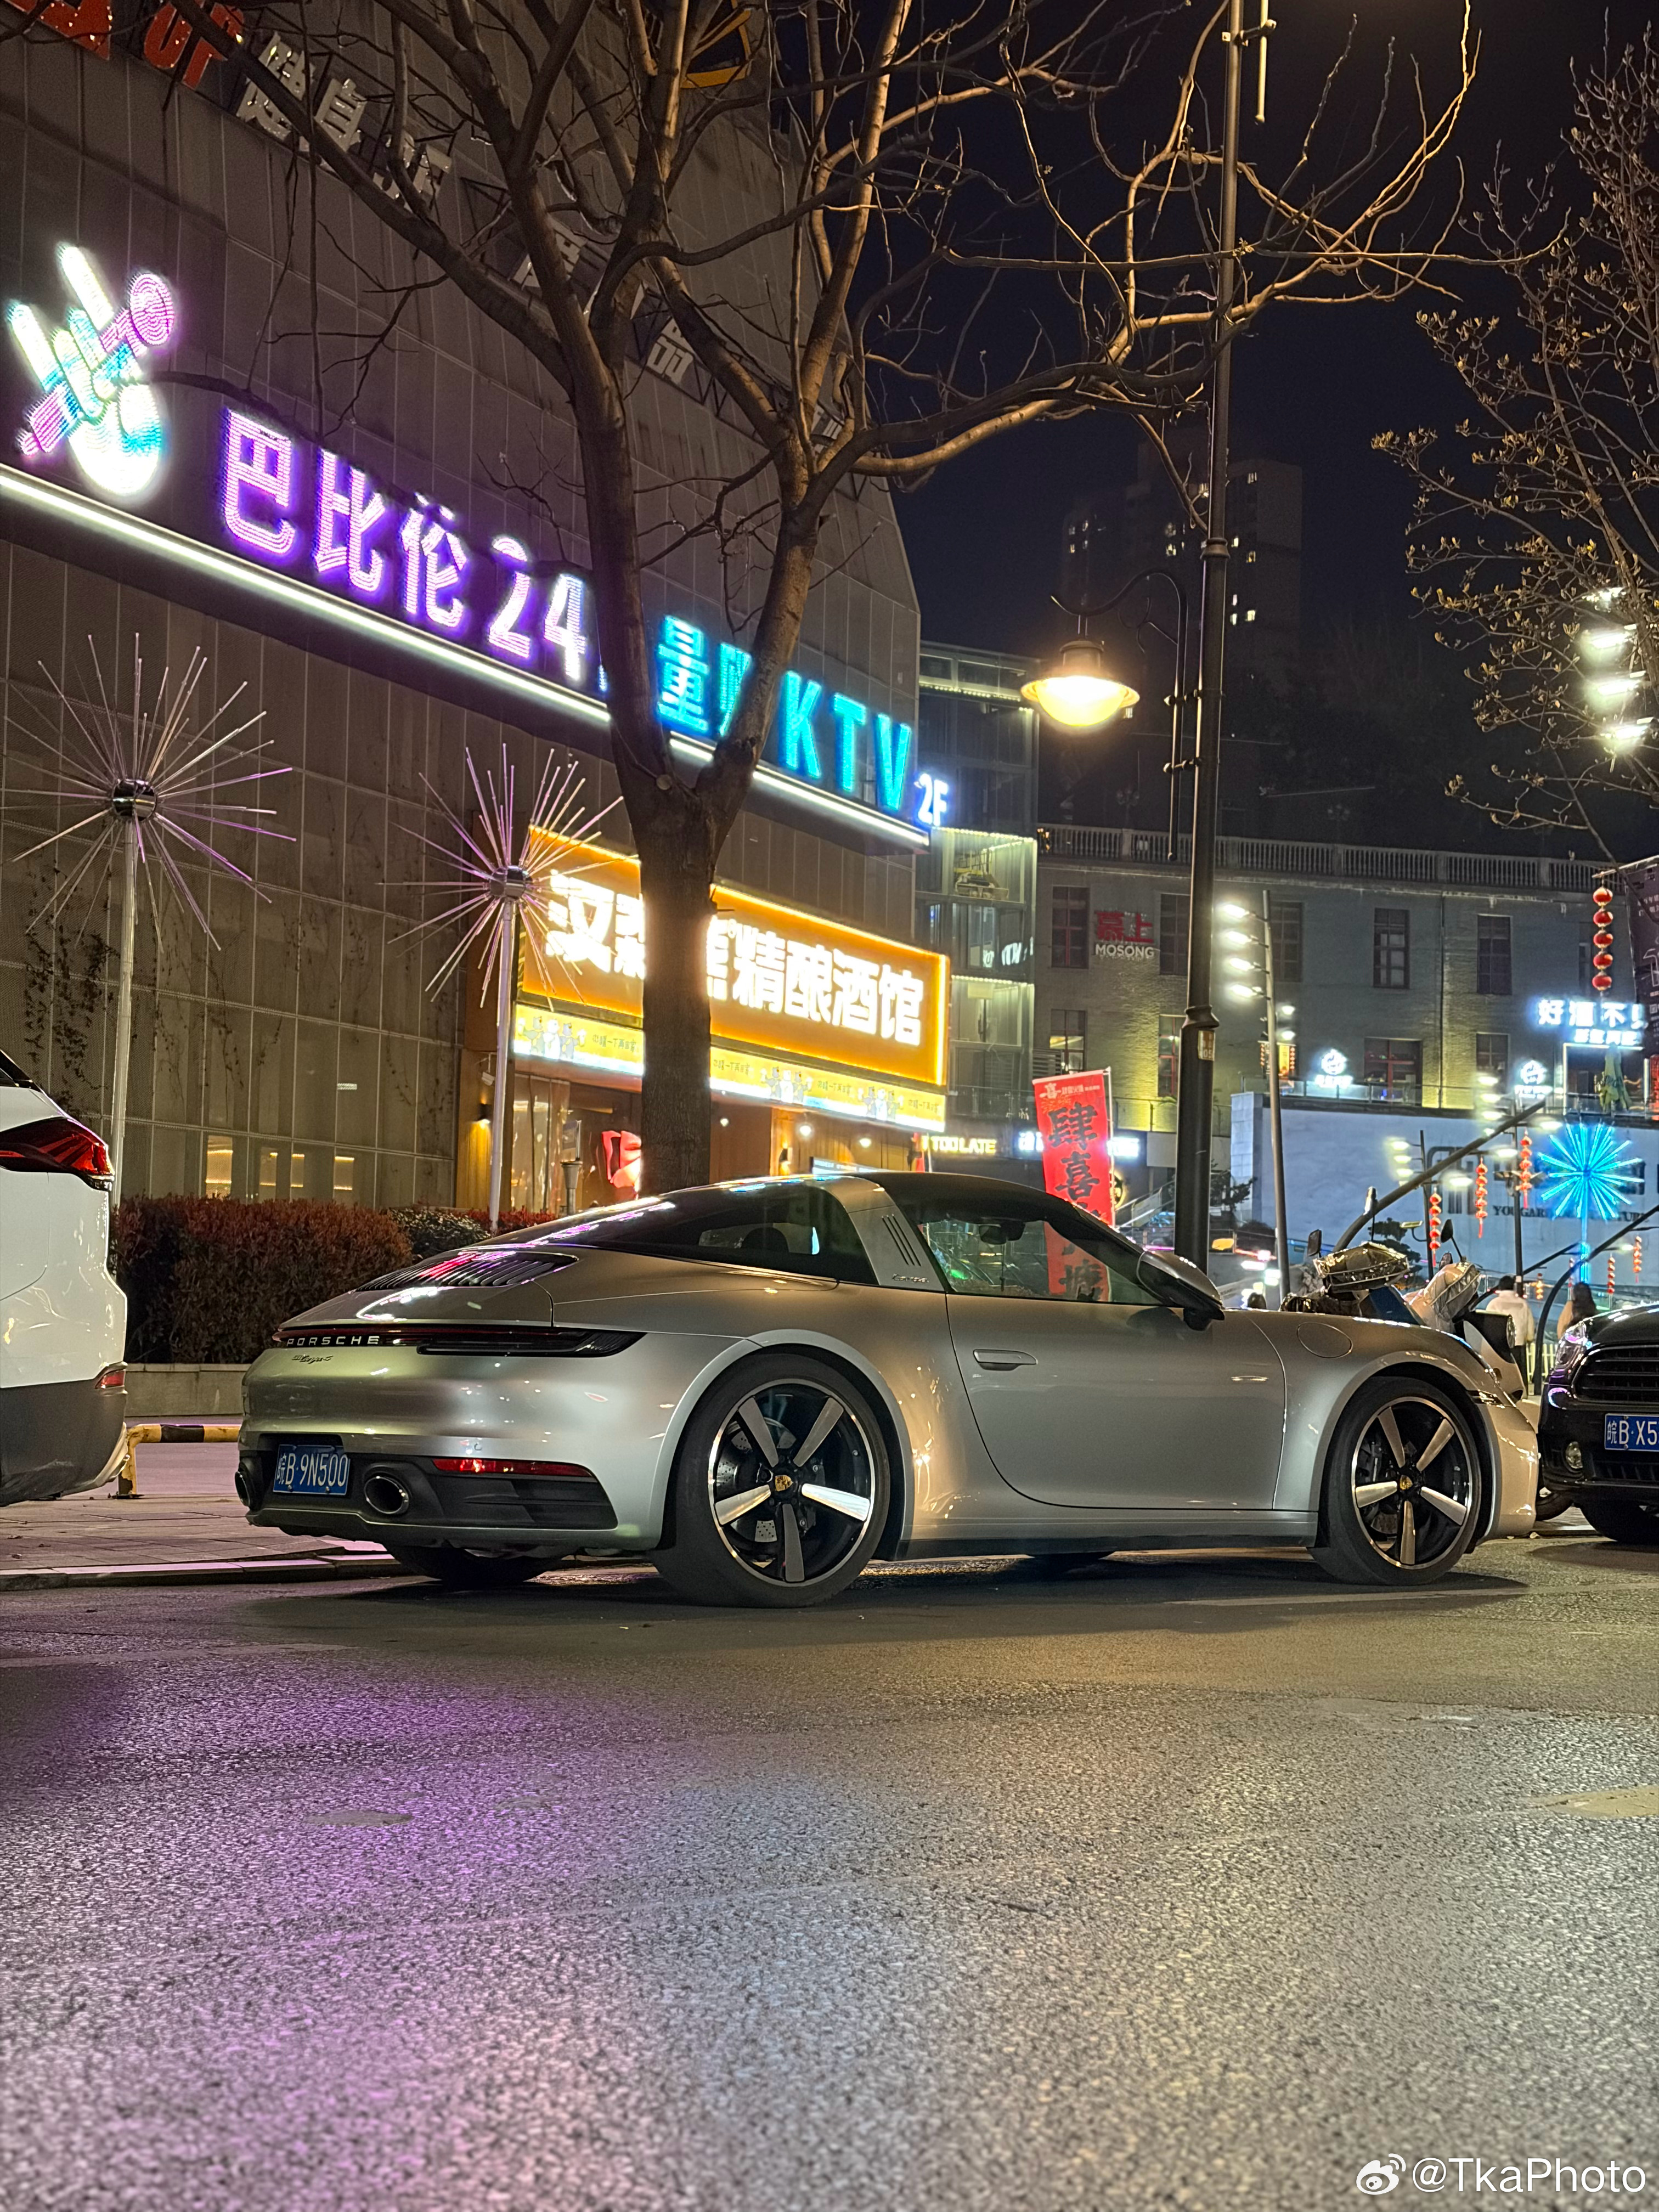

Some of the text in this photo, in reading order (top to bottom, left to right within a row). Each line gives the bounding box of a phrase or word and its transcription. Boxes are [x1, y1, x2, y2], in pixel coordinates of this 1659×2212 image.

[915, 773, 950, 827] 2F
[1095, 944, 1155, 958] MOSONG
[959, 1137, 997, 1154] LATE
[286, 1335, 380, 1347] PORSCHE
[1607, 1420, 1659, 1446] 皖B·X5
